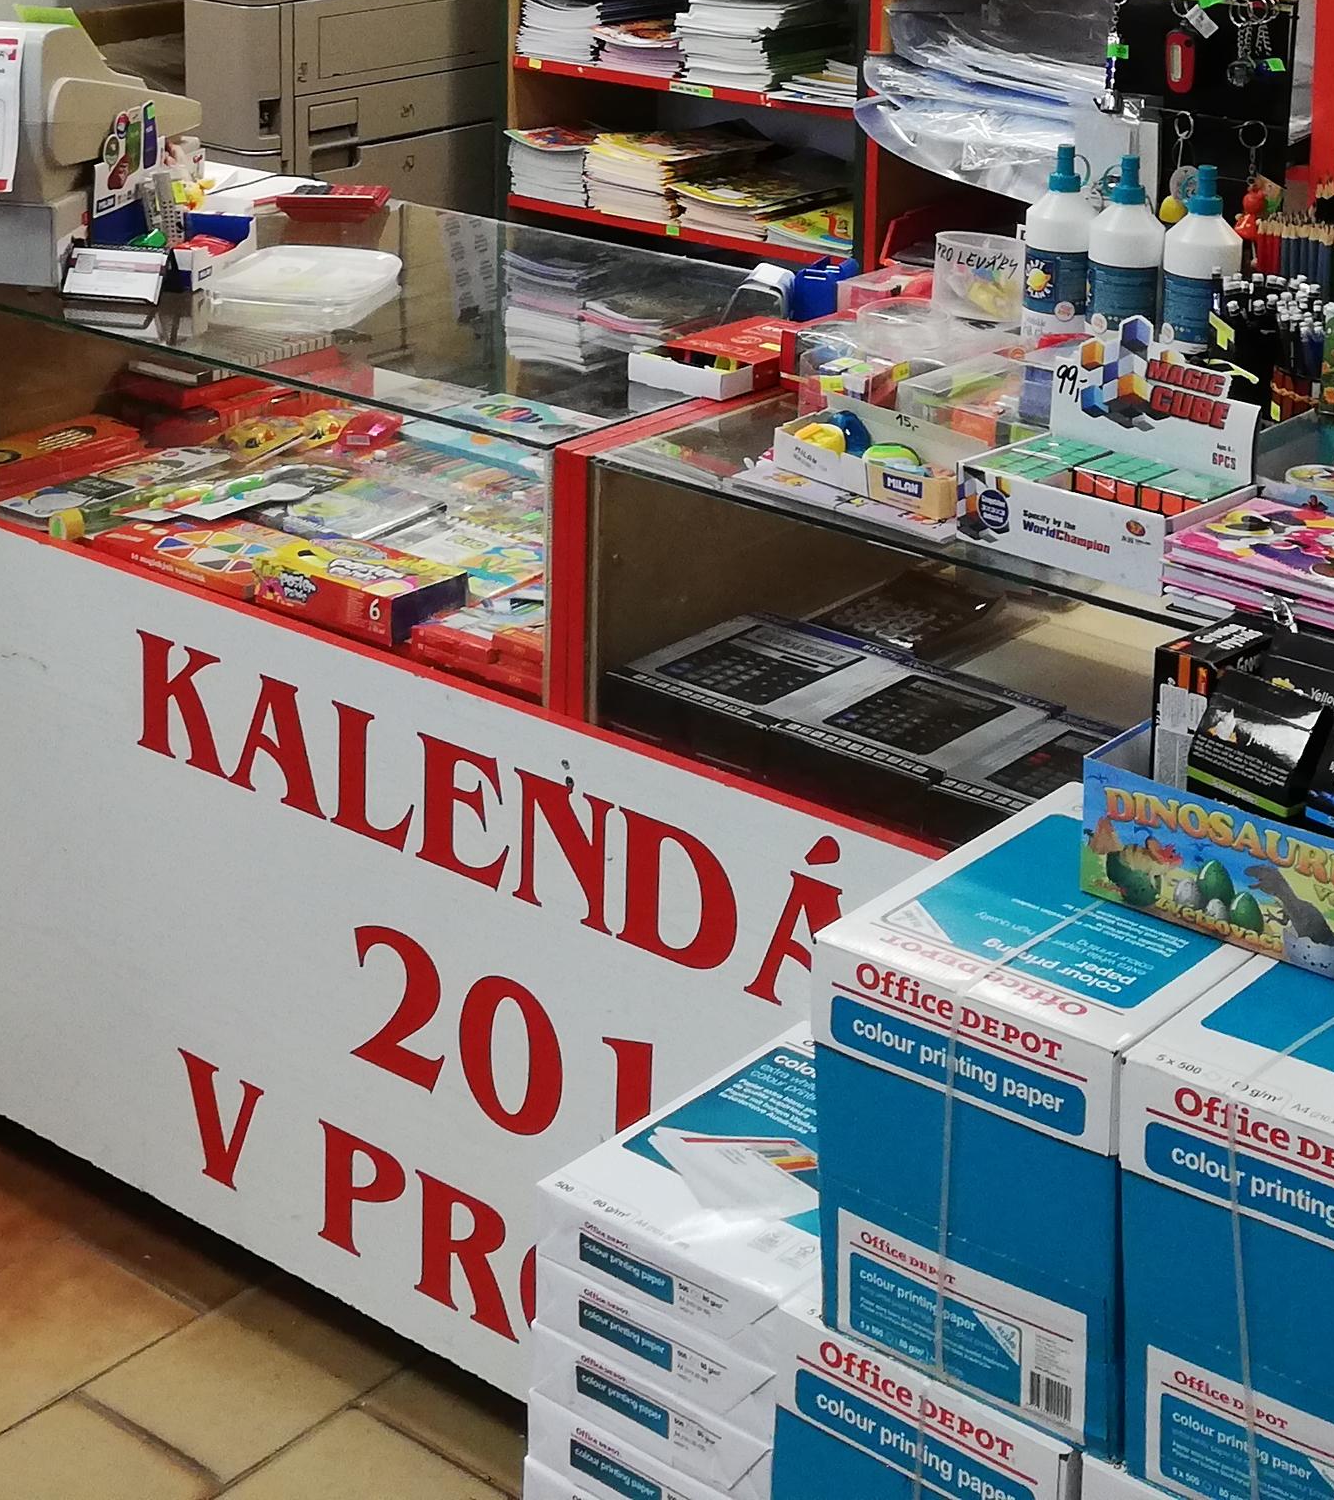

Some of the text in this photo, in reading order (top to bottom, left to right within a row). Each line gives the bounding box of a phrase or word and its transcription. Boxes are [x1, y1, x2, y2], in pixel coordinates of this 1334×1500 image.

[1145, 358, 1227, 397] MAGIC
[1150, 385, 1232, 431] CUBE
[1211, 452, 1237, 470] 6PCS
[885, 474, 921, 497] MILAN
[1023, 519, 1111, 556] WorldChampion
[369, 598, 381, 621] 6
[1074, 961, 1137, 986] paper
[855, 962, 1064, 1063] Office DEPOT
[852, 1016, 1066, 1114] colour printing paper
[1178, 1062, 1203, 1076] 500
[1173, 1085, 1291, 1151] Office
[1170, 1144, 1248, 1189] colour
[178, 1048, 536, 1354] V PR
[860, 1230, 907, 1262] Office
[859, 1268, 896, 1292] colour
[818, 1339, 1015, 1461] Office DEPOT
[1173, 1369, 1230, 1404] Office
[815, 1390, 877, 1435] colour
[956, 1456, 1019, 1500] paper
[1171, 1410, 1314, 1481] colour paper
